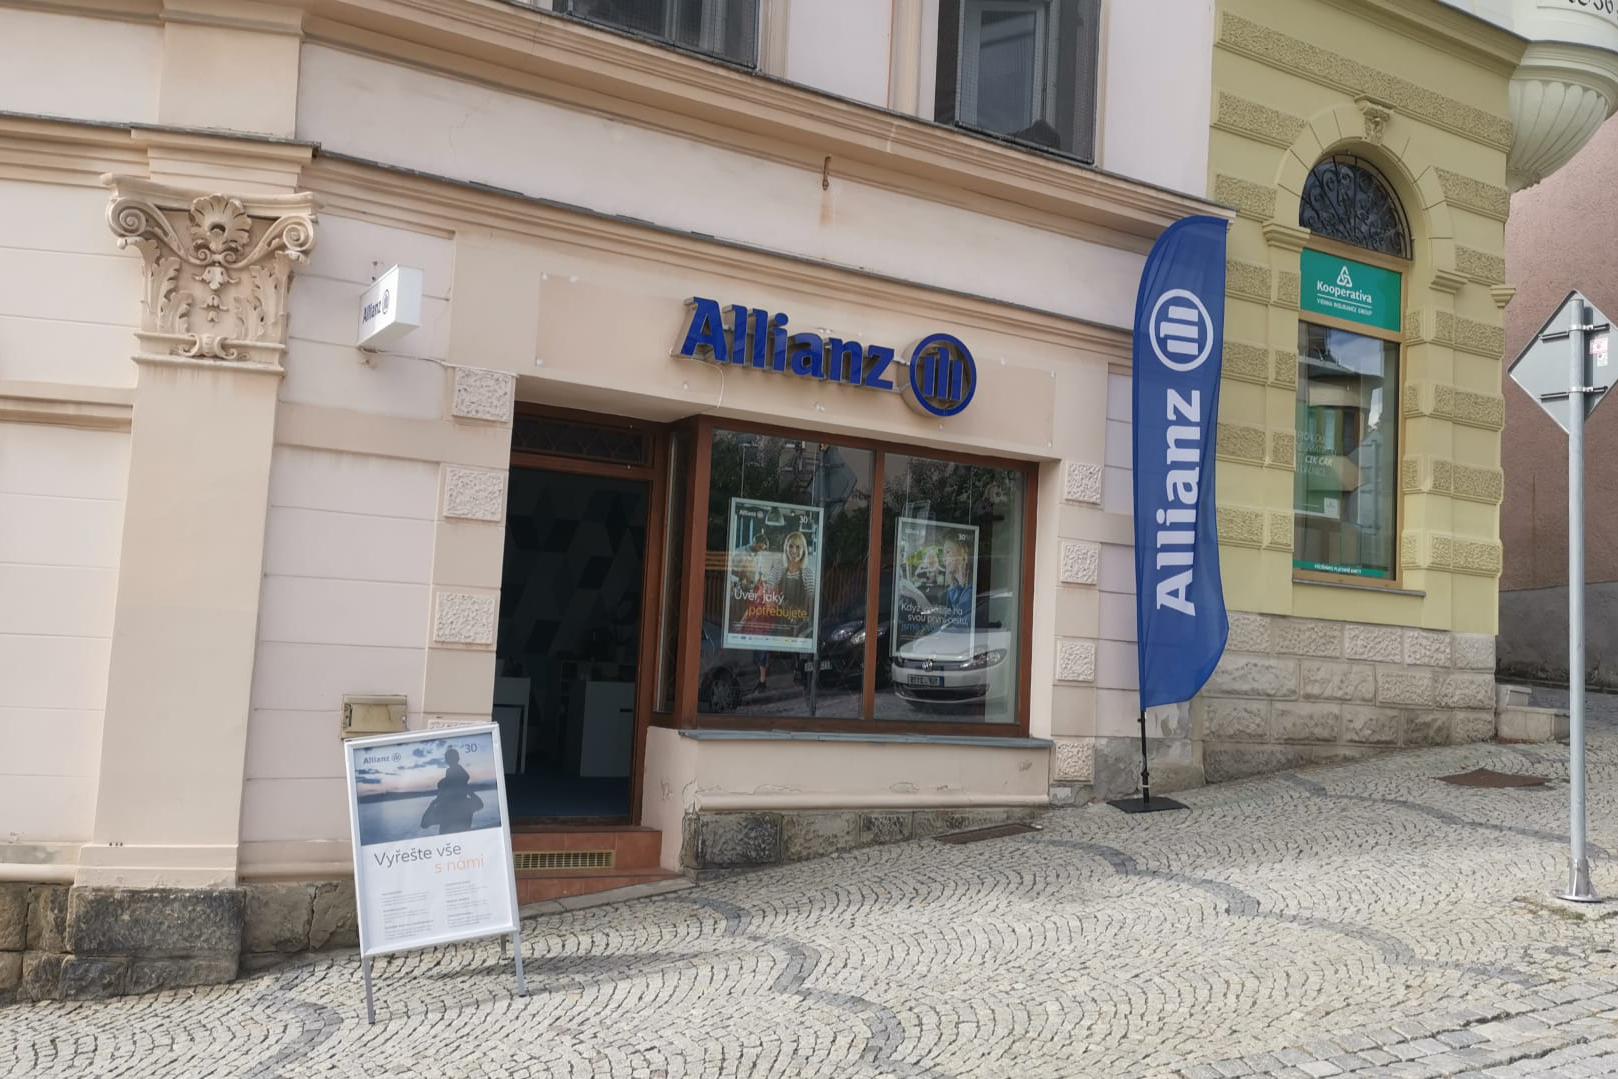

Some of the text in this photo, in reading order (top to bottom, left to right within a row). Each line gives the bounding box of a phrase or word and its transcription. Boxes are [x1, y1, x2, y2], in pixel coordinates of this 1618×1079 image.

[1316, 280, 1372, 304] Kooperativa
[362, 301, 381, 323] Allianz
[680, 297, 895, 390] Allianz
[1156, 388, 1201, 617] Allianz
[762, 591, 785, 605] jaký
[363, 755, 390, 765] Allianz
[373, 842, 462, 868] Vyřešte vše
[434, 863, 442, 873] s
